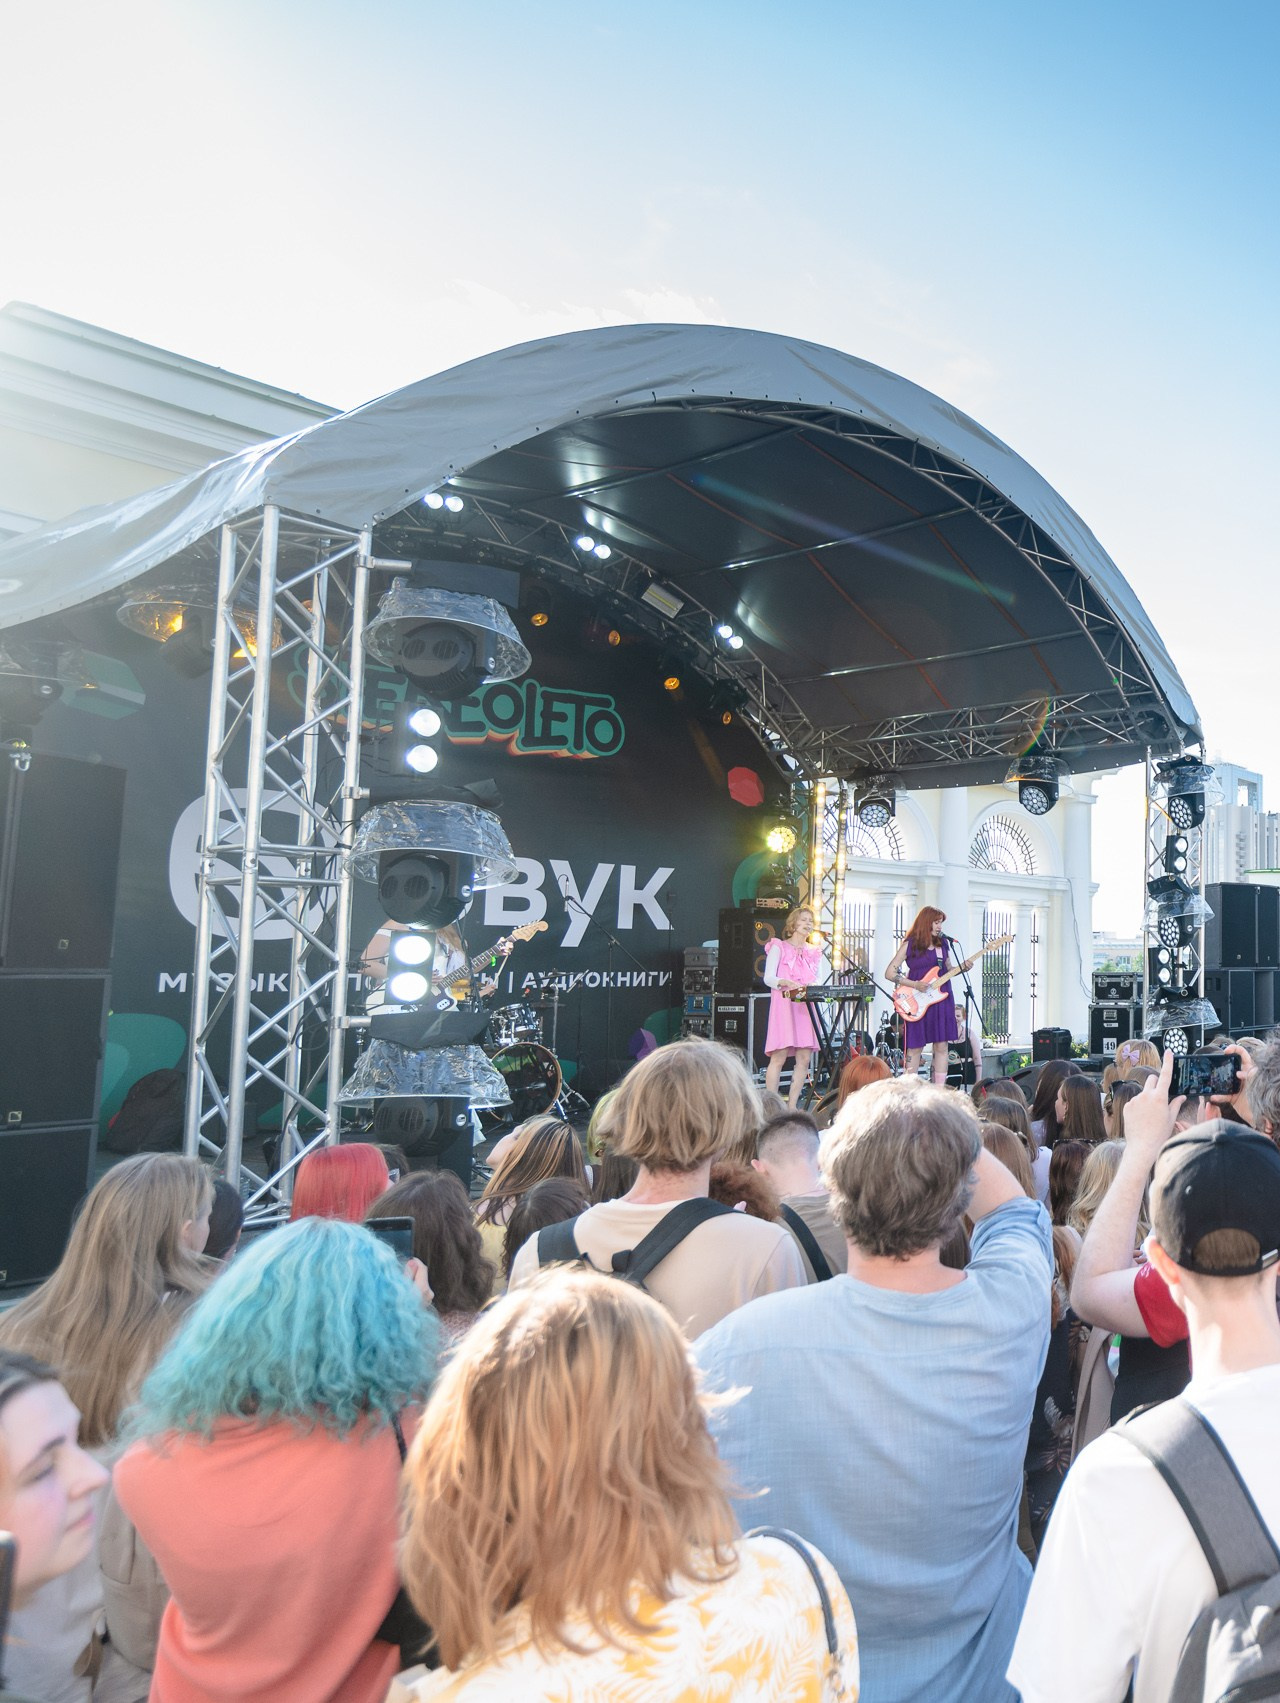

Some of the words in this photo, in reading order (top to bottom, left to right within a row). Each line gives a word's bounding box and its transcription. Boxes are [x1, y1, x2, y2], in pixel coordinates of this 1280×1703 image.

[287, 645, 626, 758] EEOLETO
[158, 971, 303, 993] МЗЫК
[1104, 1041, 1116, 1051] 49
